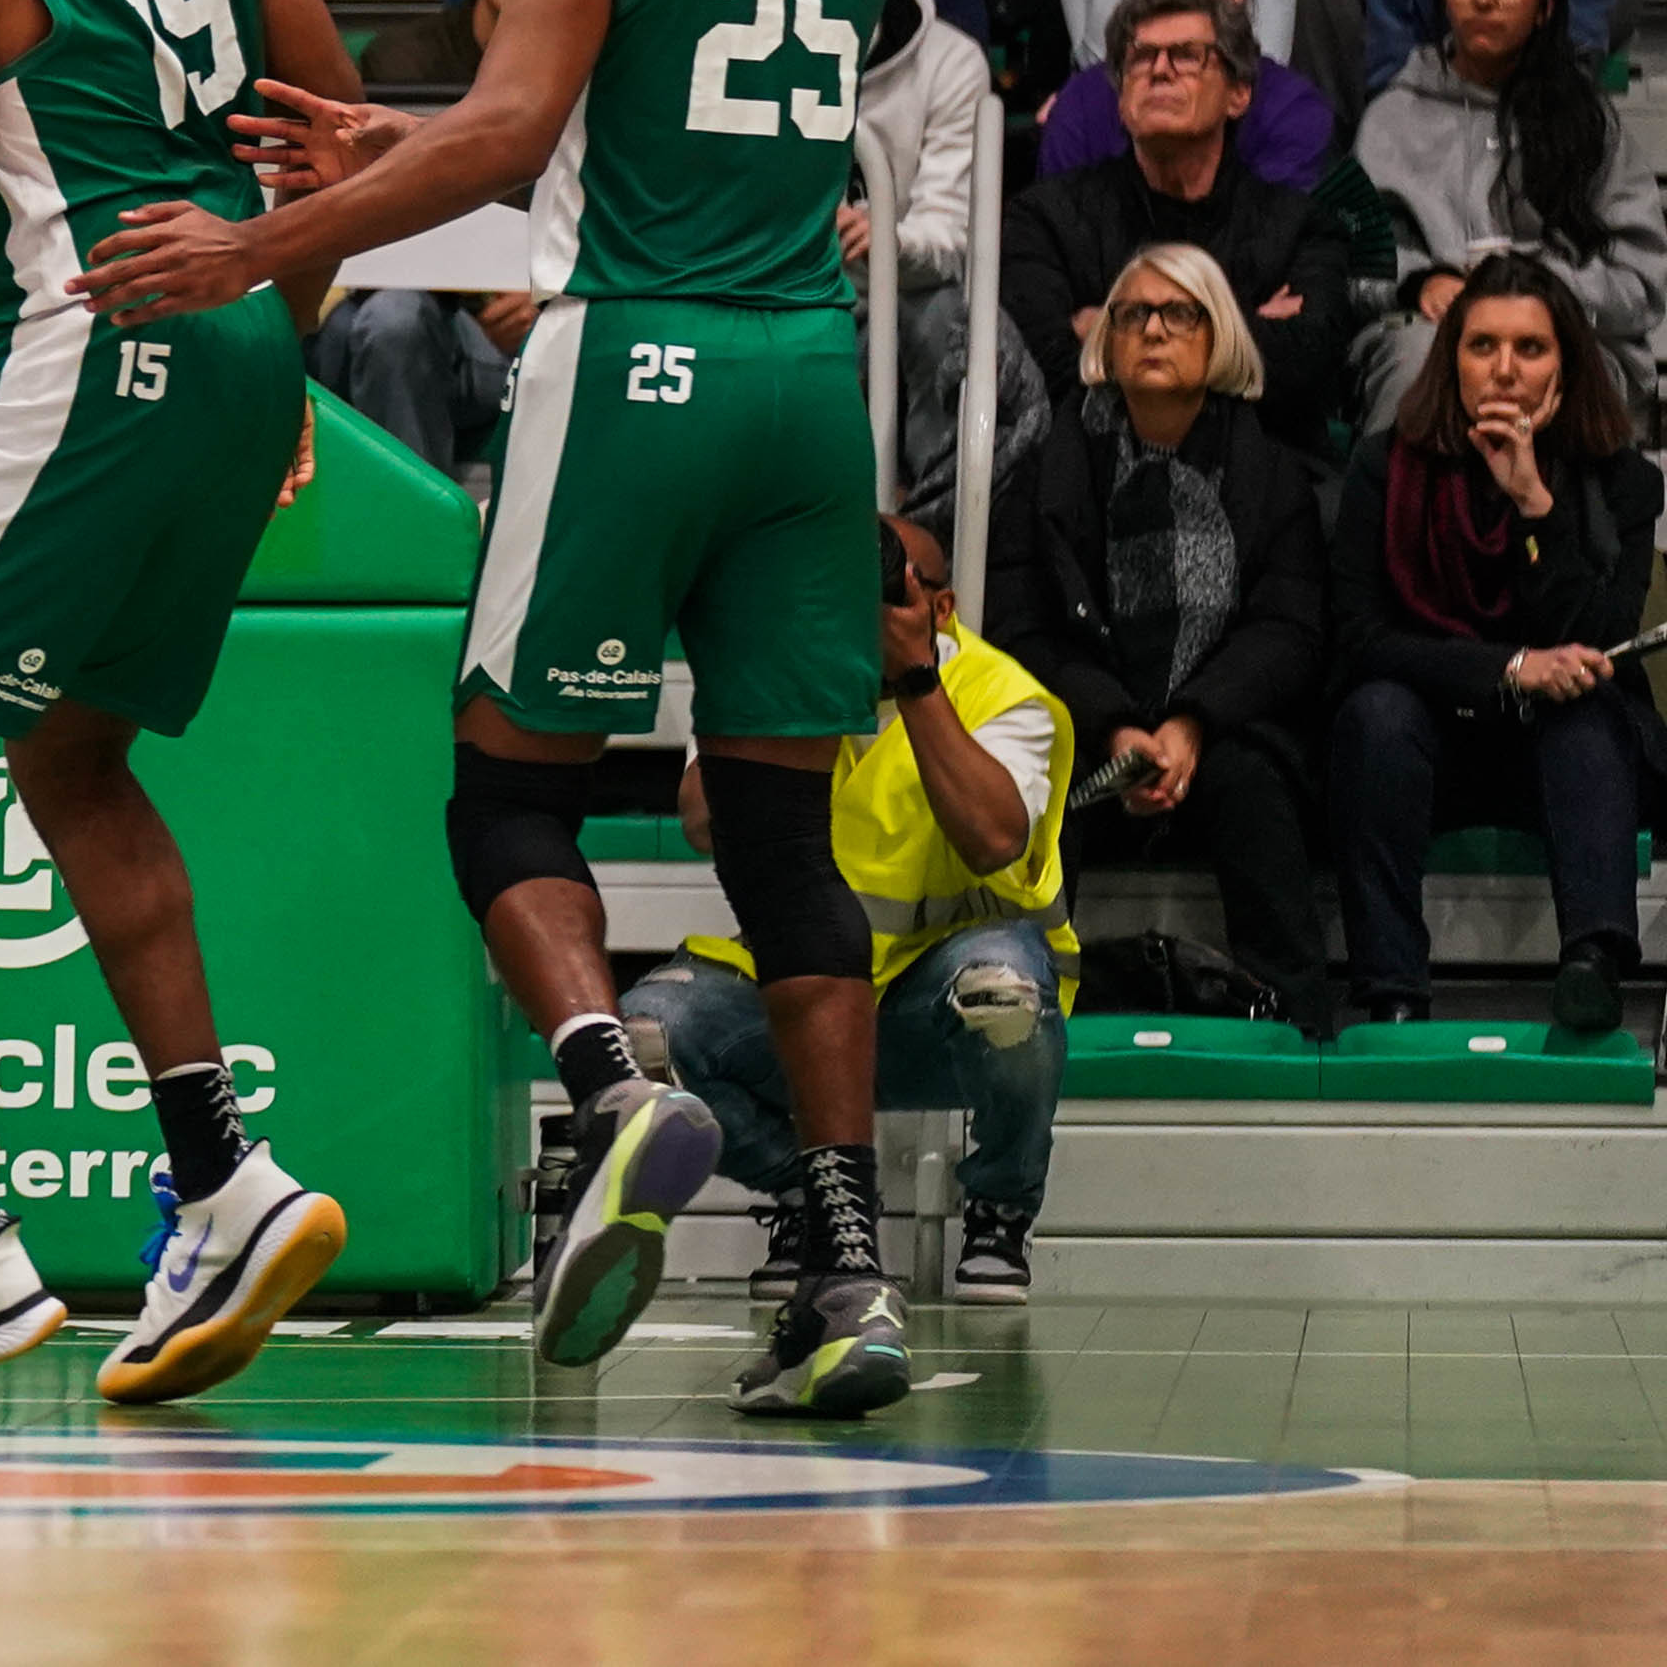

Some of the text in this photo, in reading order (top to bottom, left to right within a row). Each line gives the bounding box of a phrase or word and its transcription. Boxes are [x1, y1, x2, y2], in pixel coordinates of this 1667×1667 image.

[115, 340, 172, 402] 15
[626, 341, 697, 405] 25
[601, 644, 621, 658] 62
